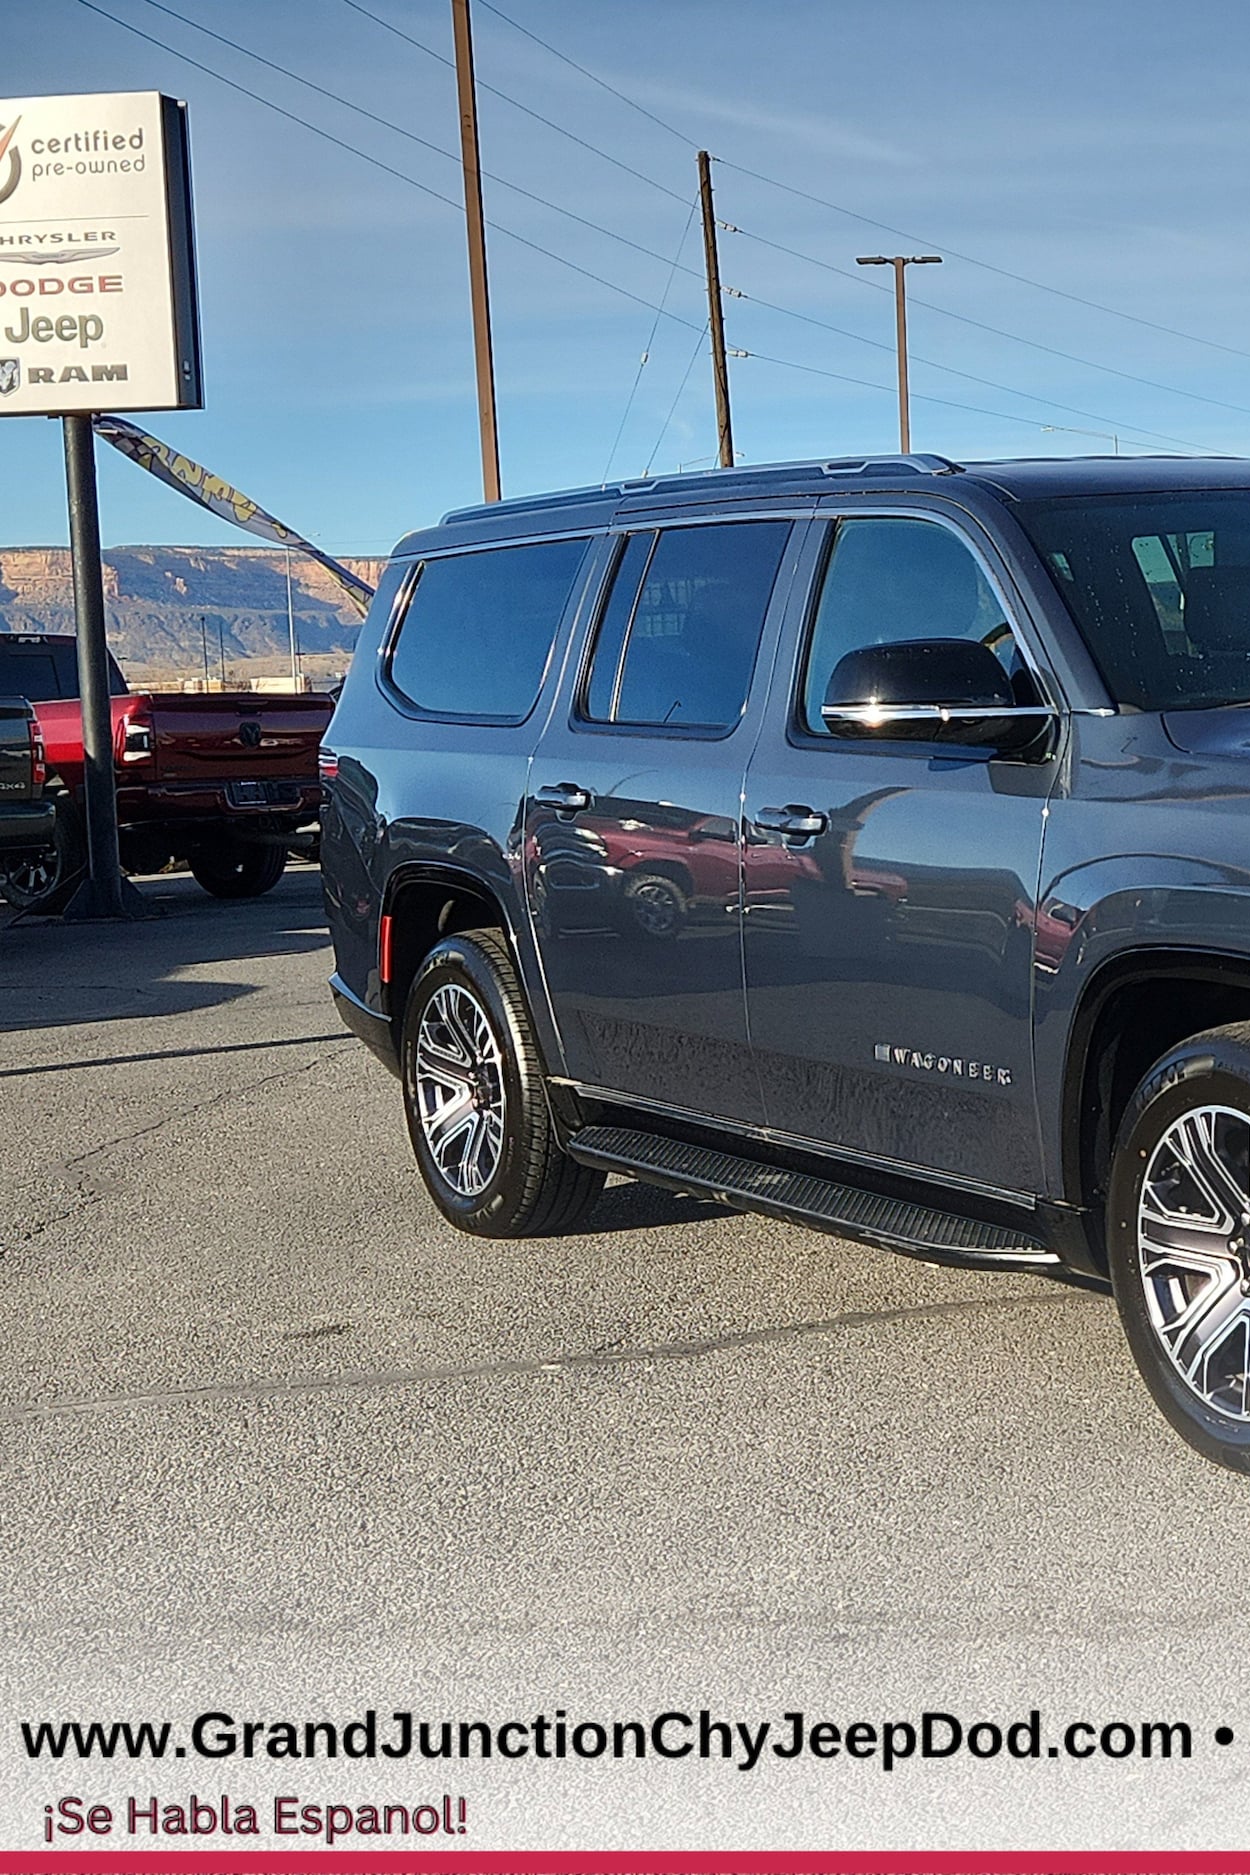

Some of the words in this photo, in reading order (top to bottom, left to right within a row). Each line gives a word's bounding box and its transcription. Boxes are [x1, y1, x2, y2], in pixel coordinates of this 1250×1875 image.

[31, 128, 144, 154] certified
[32, 155, 146, 182] pre-owned
[0, 231, 117, 246] HRYSLER
[0, 275, 124, 297] ODGE
[4, 307, 104, 349] Jeep
[28, 364, 128, 384] RAM
[893, 1047, 1012, 1086] WAGONEER
